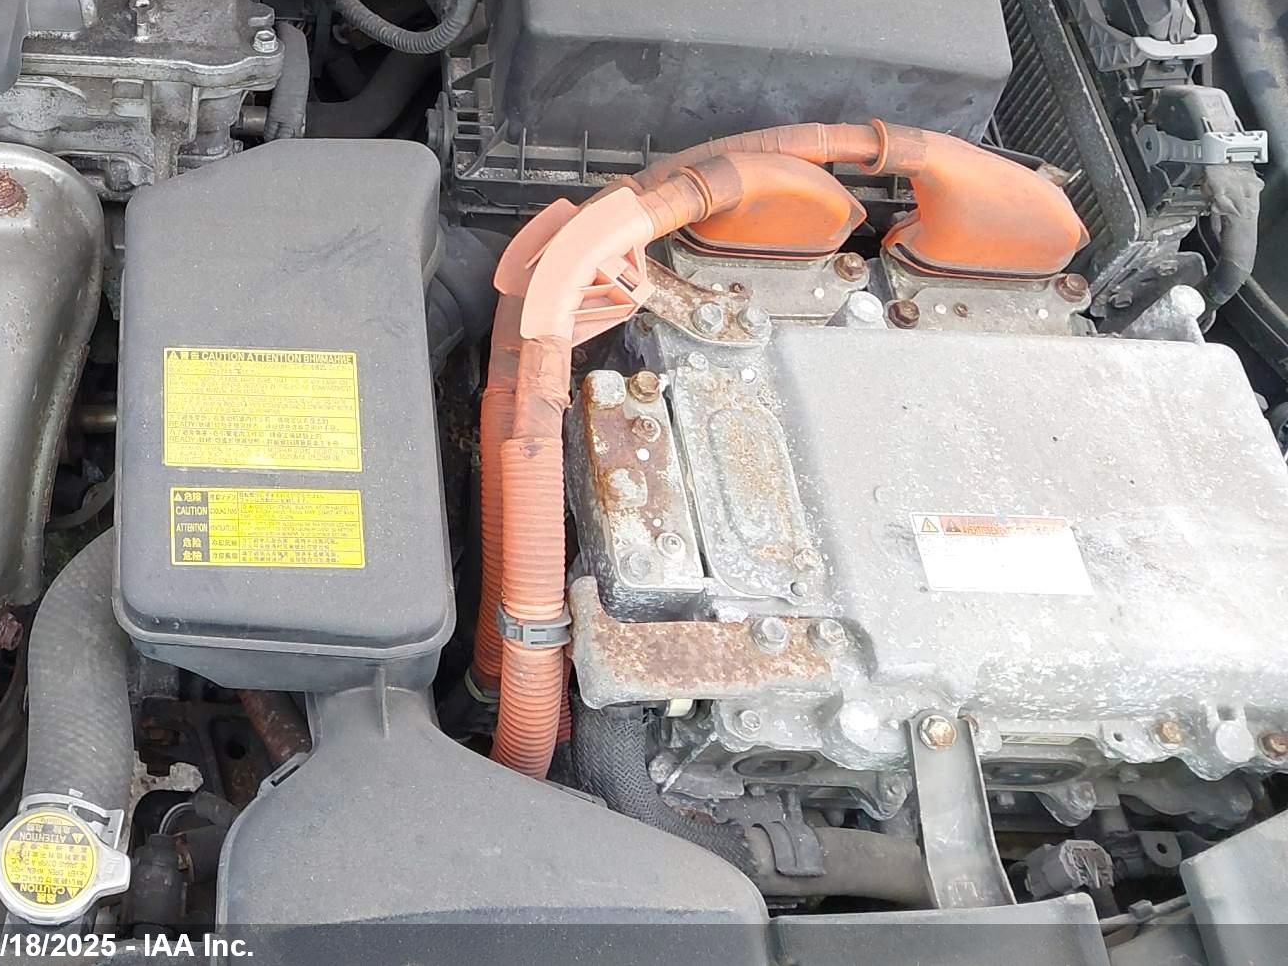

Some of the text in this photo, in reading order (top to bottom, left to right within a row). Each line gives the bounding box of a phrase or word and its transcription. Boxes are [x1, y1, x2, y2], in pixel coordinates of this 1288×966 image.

[201, 351, 244, 362] CAUTION
[246, 352, 302, 364] ATTENTION
[175, 506, 208, 516] CAUTION
[176, 522, 208, 532] ATTENTION
[19, 832, 67, 843] ATTENTION
[19, 883, 66, 895] CAUTION
